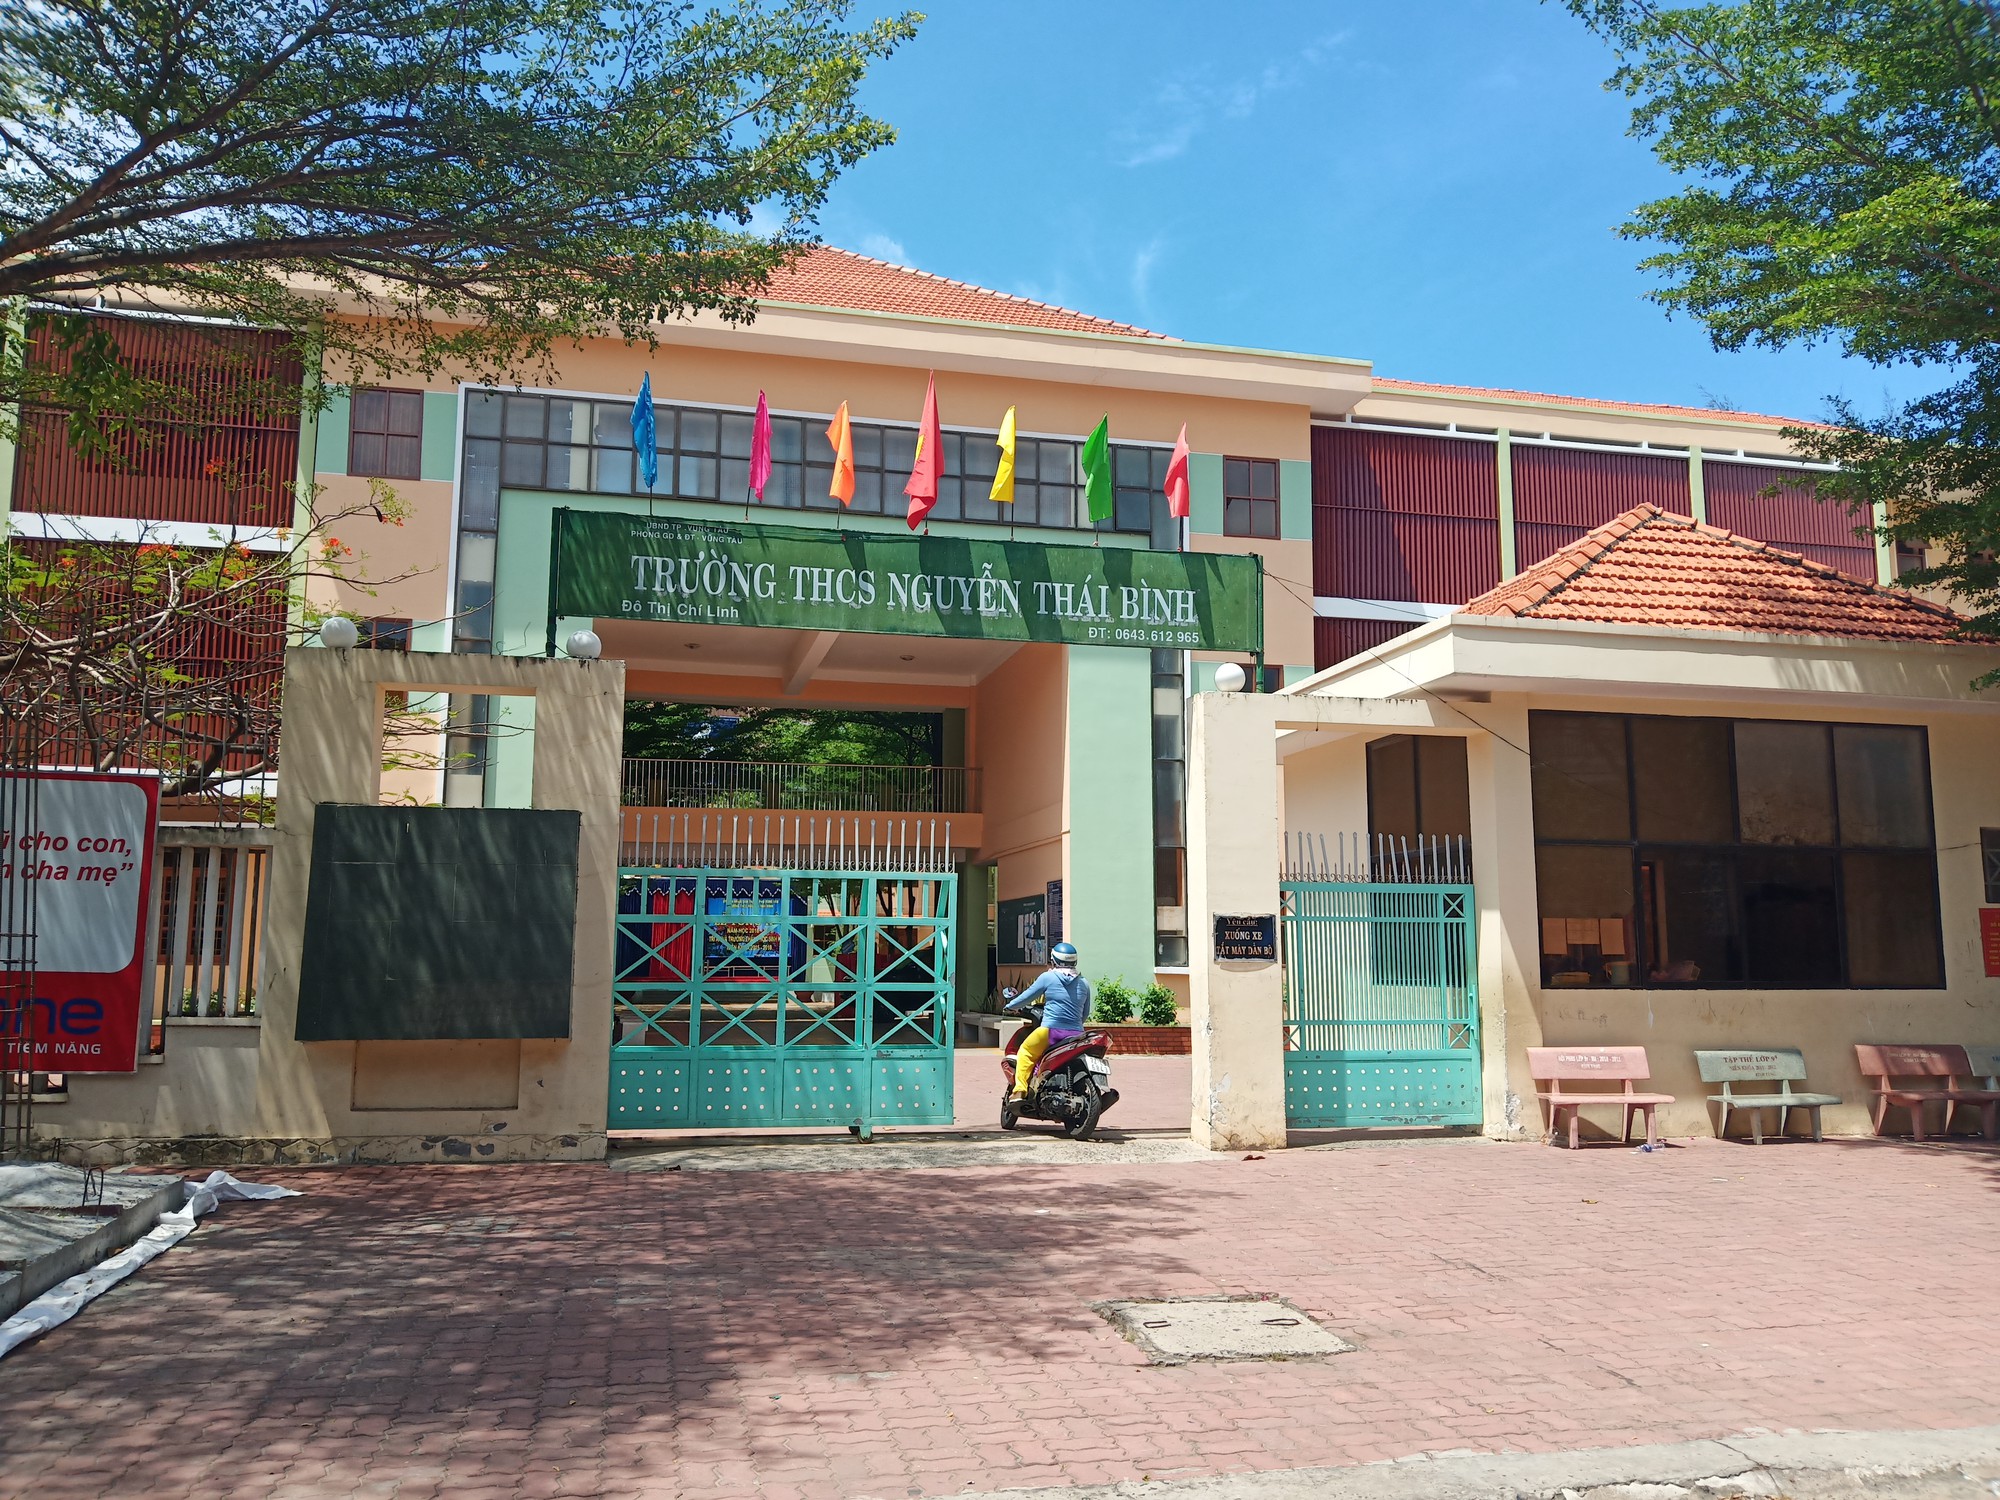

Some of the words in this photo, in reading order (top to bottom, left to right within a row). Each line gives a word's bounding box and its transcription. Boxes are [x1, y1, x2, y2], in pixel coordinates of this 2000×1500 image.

[662, 532, 675, 540] GD
[630, 549, 777, 599] TRƯỜNG
[789, 565, 876, 605] THCS
[886, 562, 1021, 614] NGUYỄN
[1033, 574, 1111, 618] THÁI
[1120, 579, 1197, 623] BÌNH
[621, 600, 643, 613] Đô
[648, 601, 671, 616] Thị
[677, 602, 702, 617] Chí
[707, 604, 739, 618] Linh
[1088, 627, 1111, 639] ĐT:
[1176, 630, 1199, 643] 965
[19, 831, 68, 851] cho
[77, 837, 131, 857] con,
[21, 860, 69, 880] cha
[1225, 927, 1250, 940] XUỐNG
[1252, 931, 1263, 940] XE
[1231, 944, 1247, 955] MÁY
[55, 1041, 101, 1055] NĂNG
